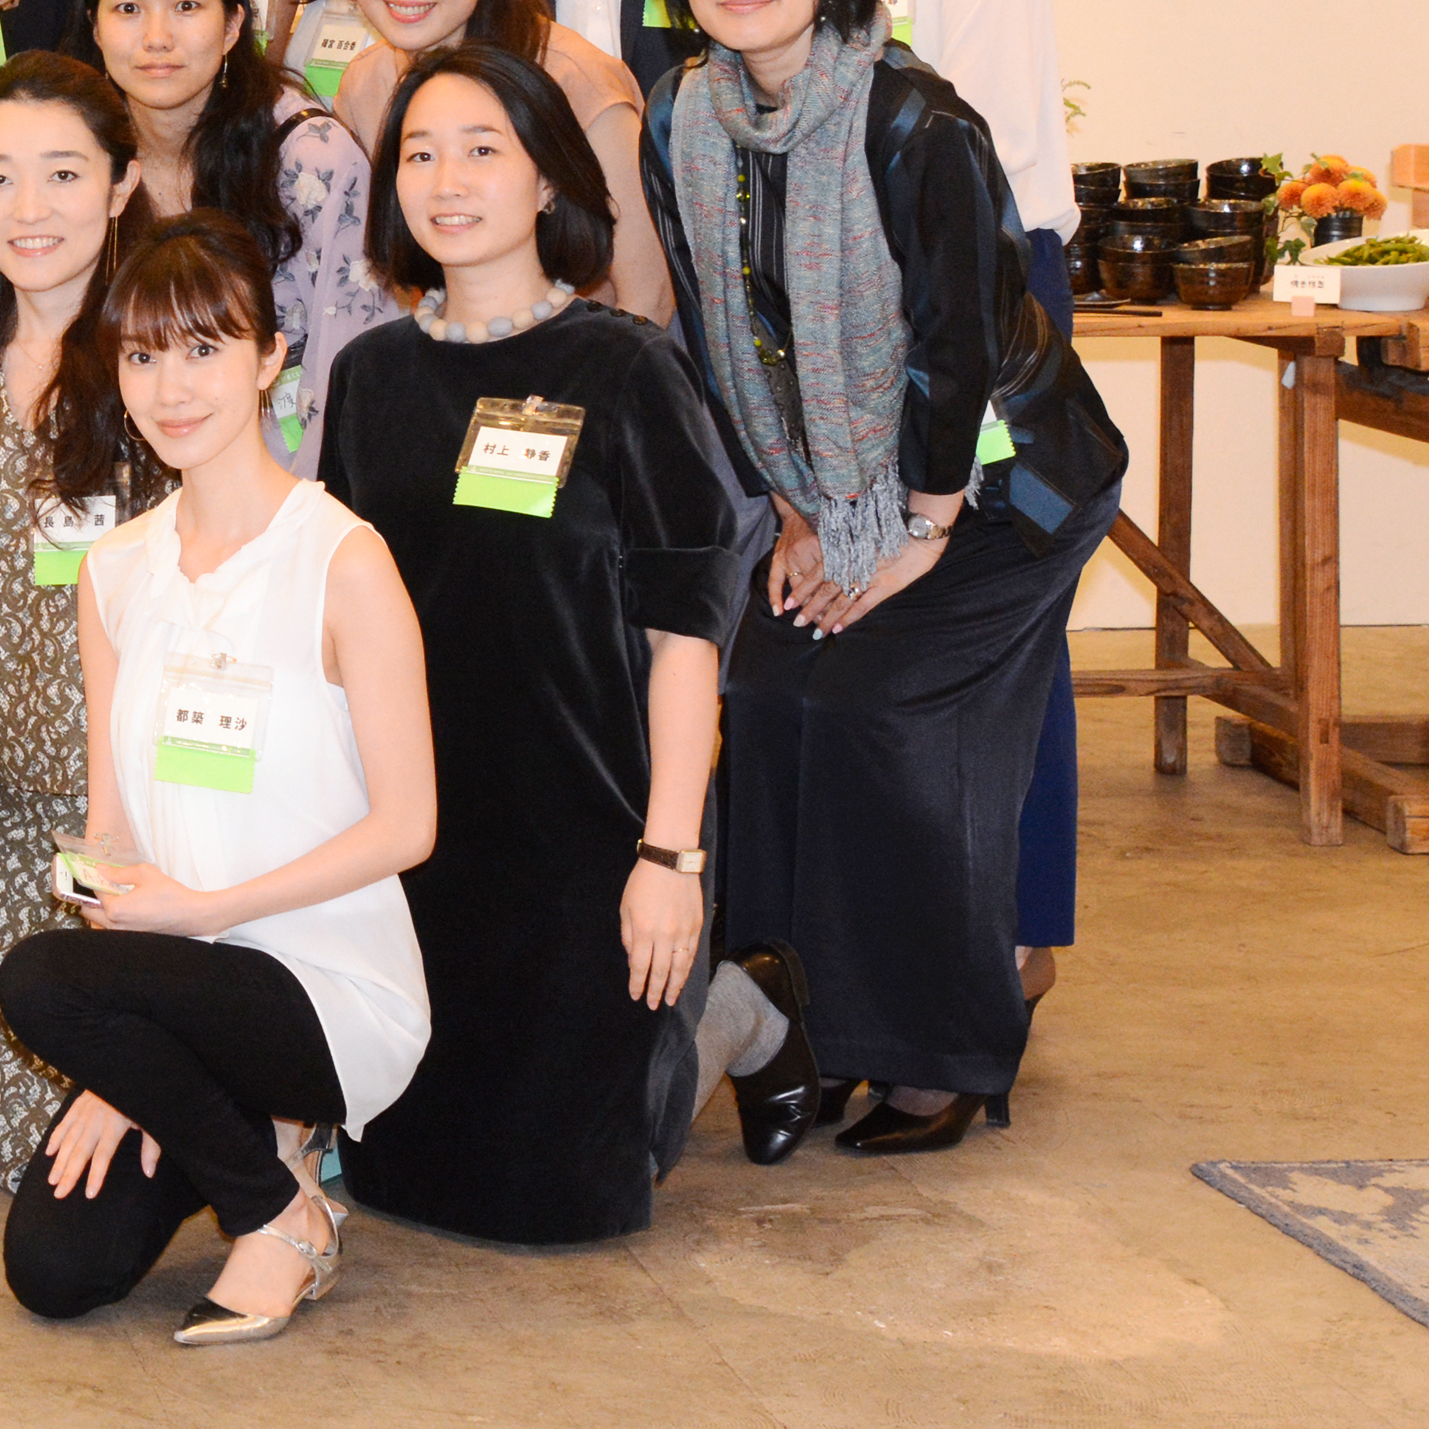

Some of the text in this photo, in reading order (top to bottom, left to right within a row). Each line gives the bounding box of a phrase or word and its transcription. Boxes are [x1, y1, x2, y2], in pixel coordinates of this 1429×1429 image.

[483, 443, 509, 456] 村上
[176, 708, 247, 730] 都築 理沙
